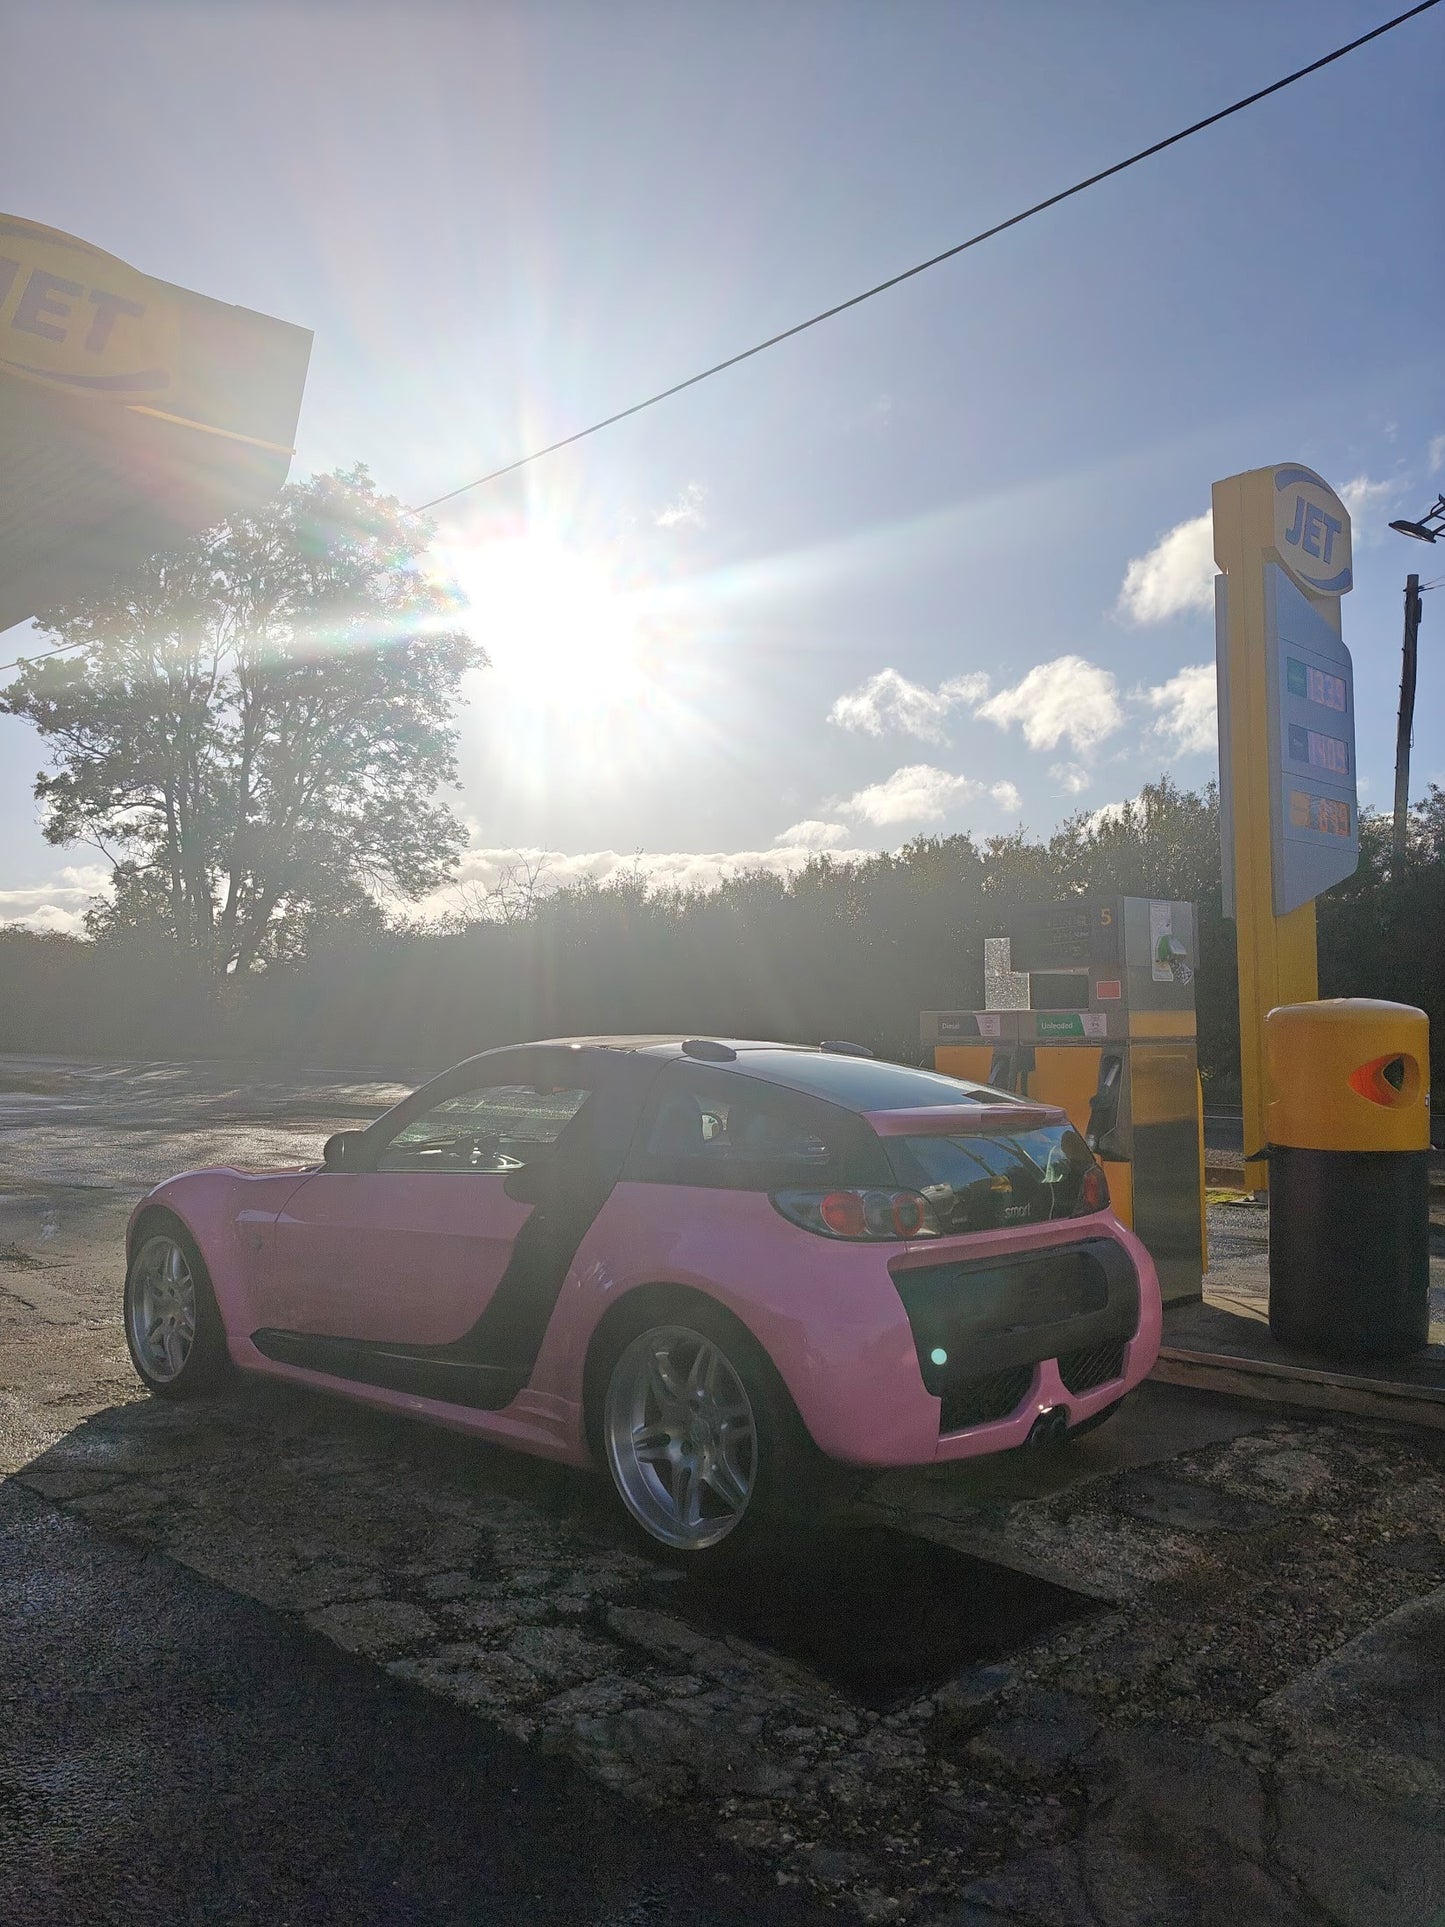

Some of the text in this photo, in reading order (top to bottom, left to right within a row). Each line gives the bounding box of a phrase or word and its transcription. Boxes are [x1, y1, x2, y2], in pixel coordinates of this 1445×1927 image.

[1285, 495, 1342, 565] JET
[1101, 908, 1113, 926] 5
[942, 1022, 960, 1030] Diesel
[1041, 1022, 1074, 1030] Unleaded
[1004, 1202, 1031, 1218] smart
